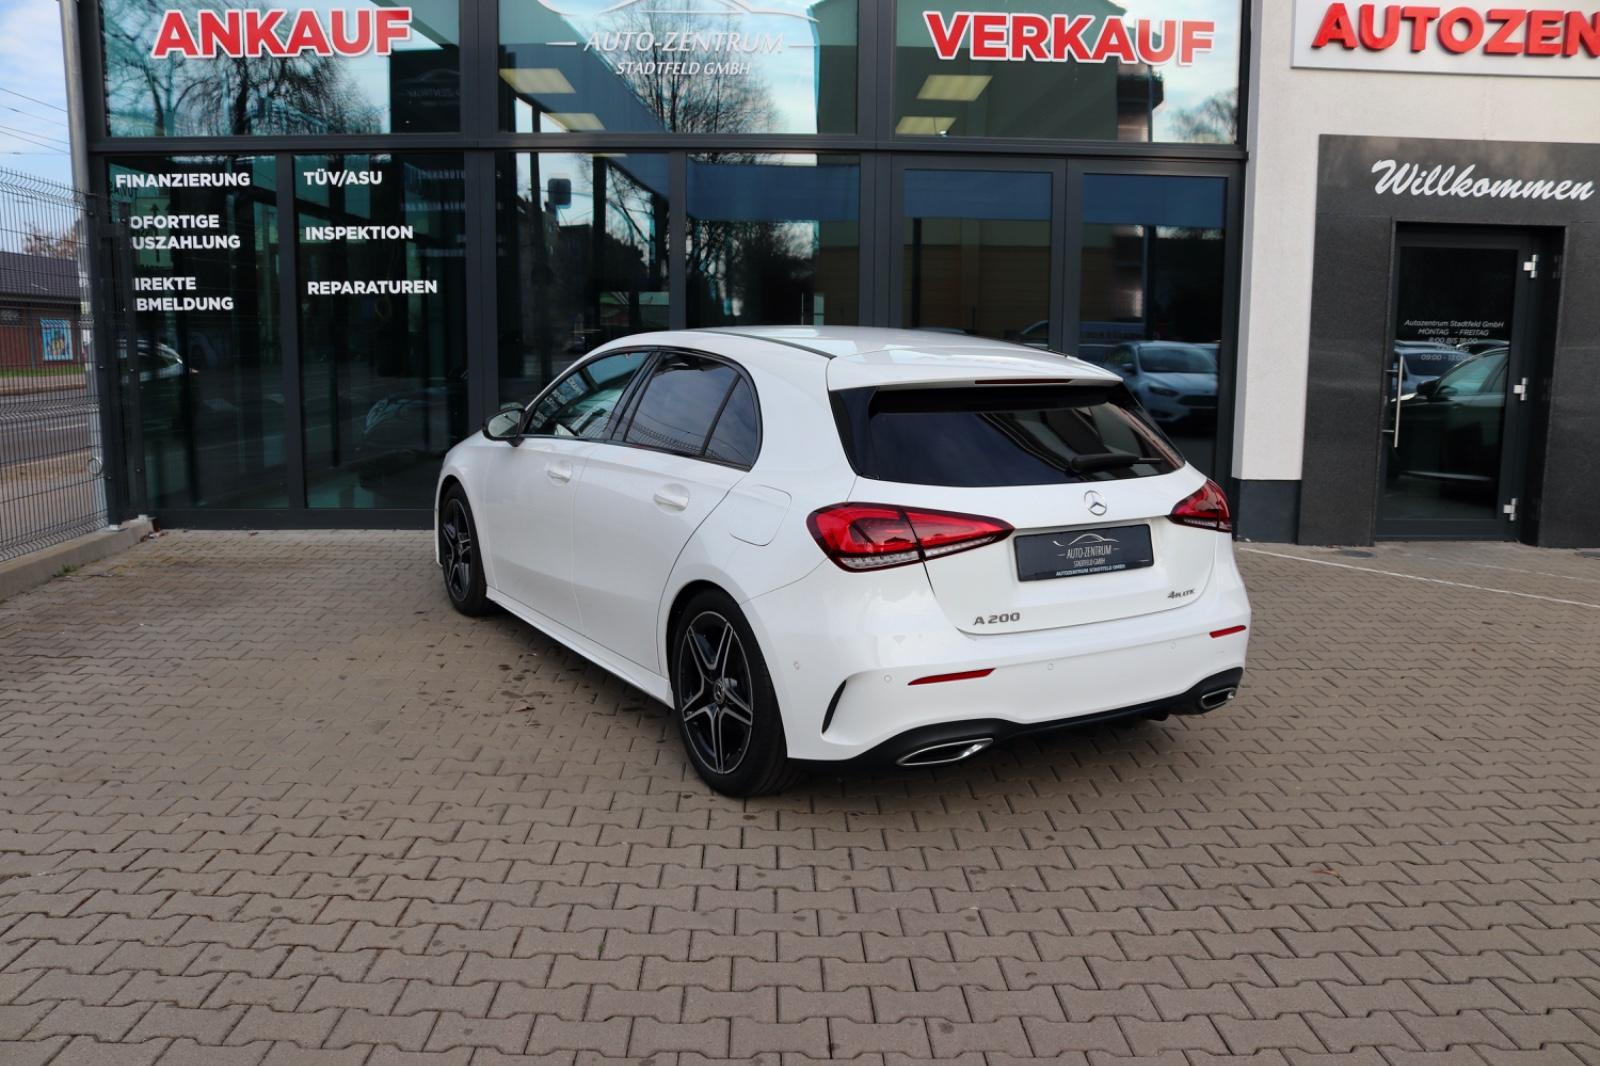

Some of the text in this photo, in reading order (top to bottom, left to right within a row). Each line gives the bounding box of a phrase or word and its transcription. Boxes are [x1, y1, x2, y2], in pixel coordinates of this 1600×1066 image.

[151, 7, 411, 59] ANKAUF
[1310, 2, 1600, 58] AUTOZEN
[584, 31, 785, 54] AUTO-ZENTRUM
[923, 11, 1215, 66] VERKAUF
[615, 61, 752, 76] STADTFELD GMBH
[115, 172, 251, 188] FINANZIERUNG
[303, 168, 383, 187] TÜV/ASU
[1371, 160, 1595, 201] Willkommen
[130, 214, 220, 229] OFORTIGE
[305, 225, 414, 241] INSPEKTION
[132, 234, 241, 250] USZAHLUNG
[134, 276, 197, 291] IREKTE
[307, 280, 438, 295] REPARATUREN
[136, 296, 234, 311] BMELDUNG
[1404, 319, 1504, 328] Autozentrum Stadtfeld GmbH
[1417, 328, 1449, 336] MONTAG
[1459, 329, 1489, 337] FREITAG
[1066, 544, 1112, 559] AUTO-ZENTRUM
[973, 612, 1020, 626] A 200
